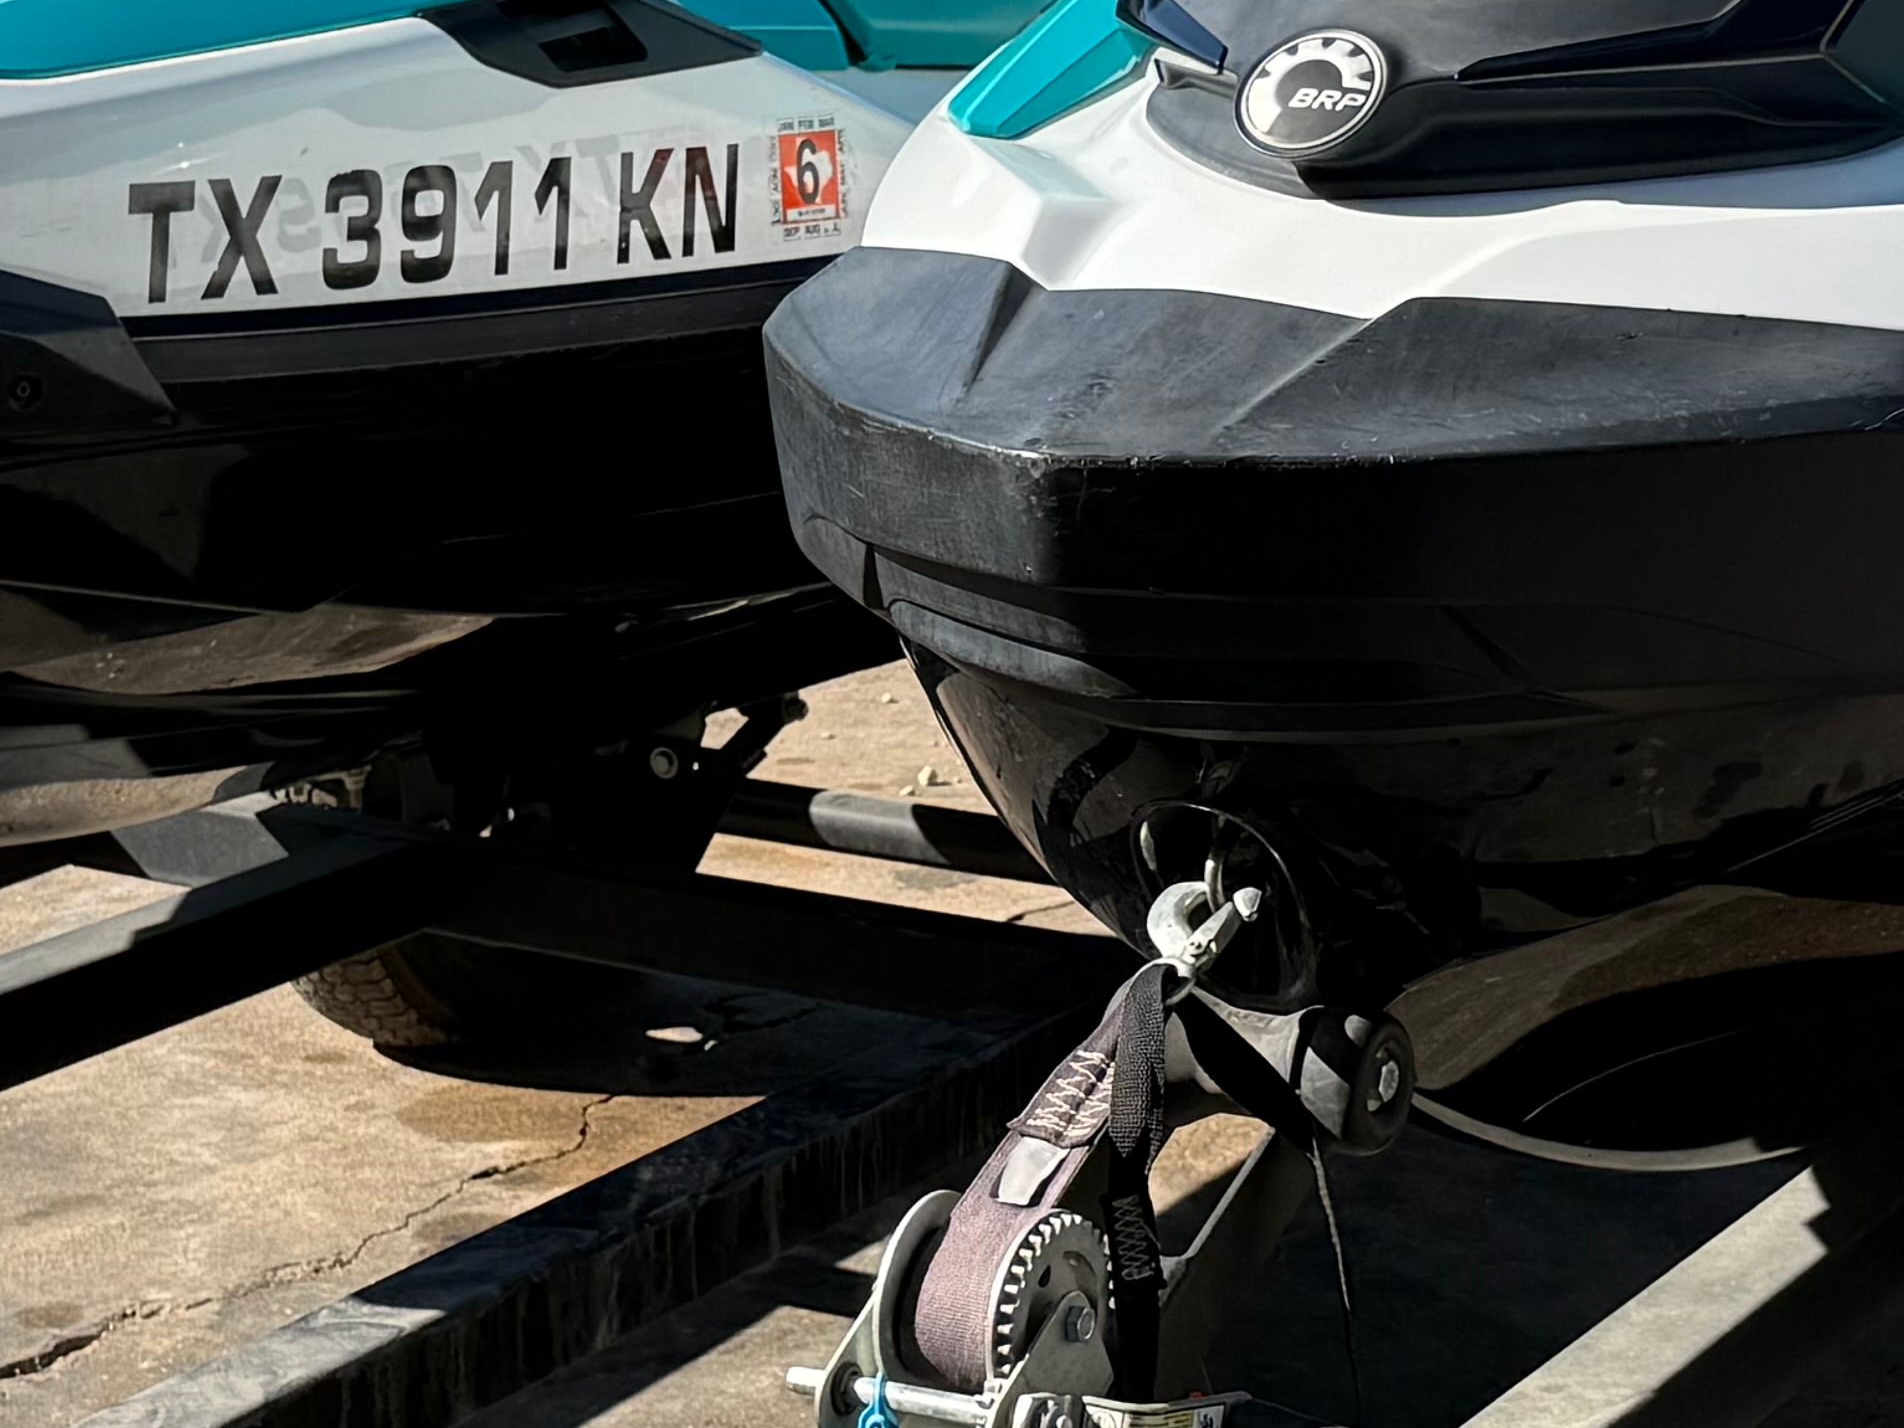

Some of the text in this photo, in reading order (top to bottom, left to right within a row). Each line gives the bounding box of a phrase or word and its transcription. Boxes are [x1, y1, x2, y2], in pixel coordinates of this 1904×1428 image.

[1288, 87, 1367, 111] BRP
[797, 139, 819, 204] 6
[128, 174, 282, 303] TX
[323, 156, 572, 291] 3911
[617, 142, 739, 264] KN
